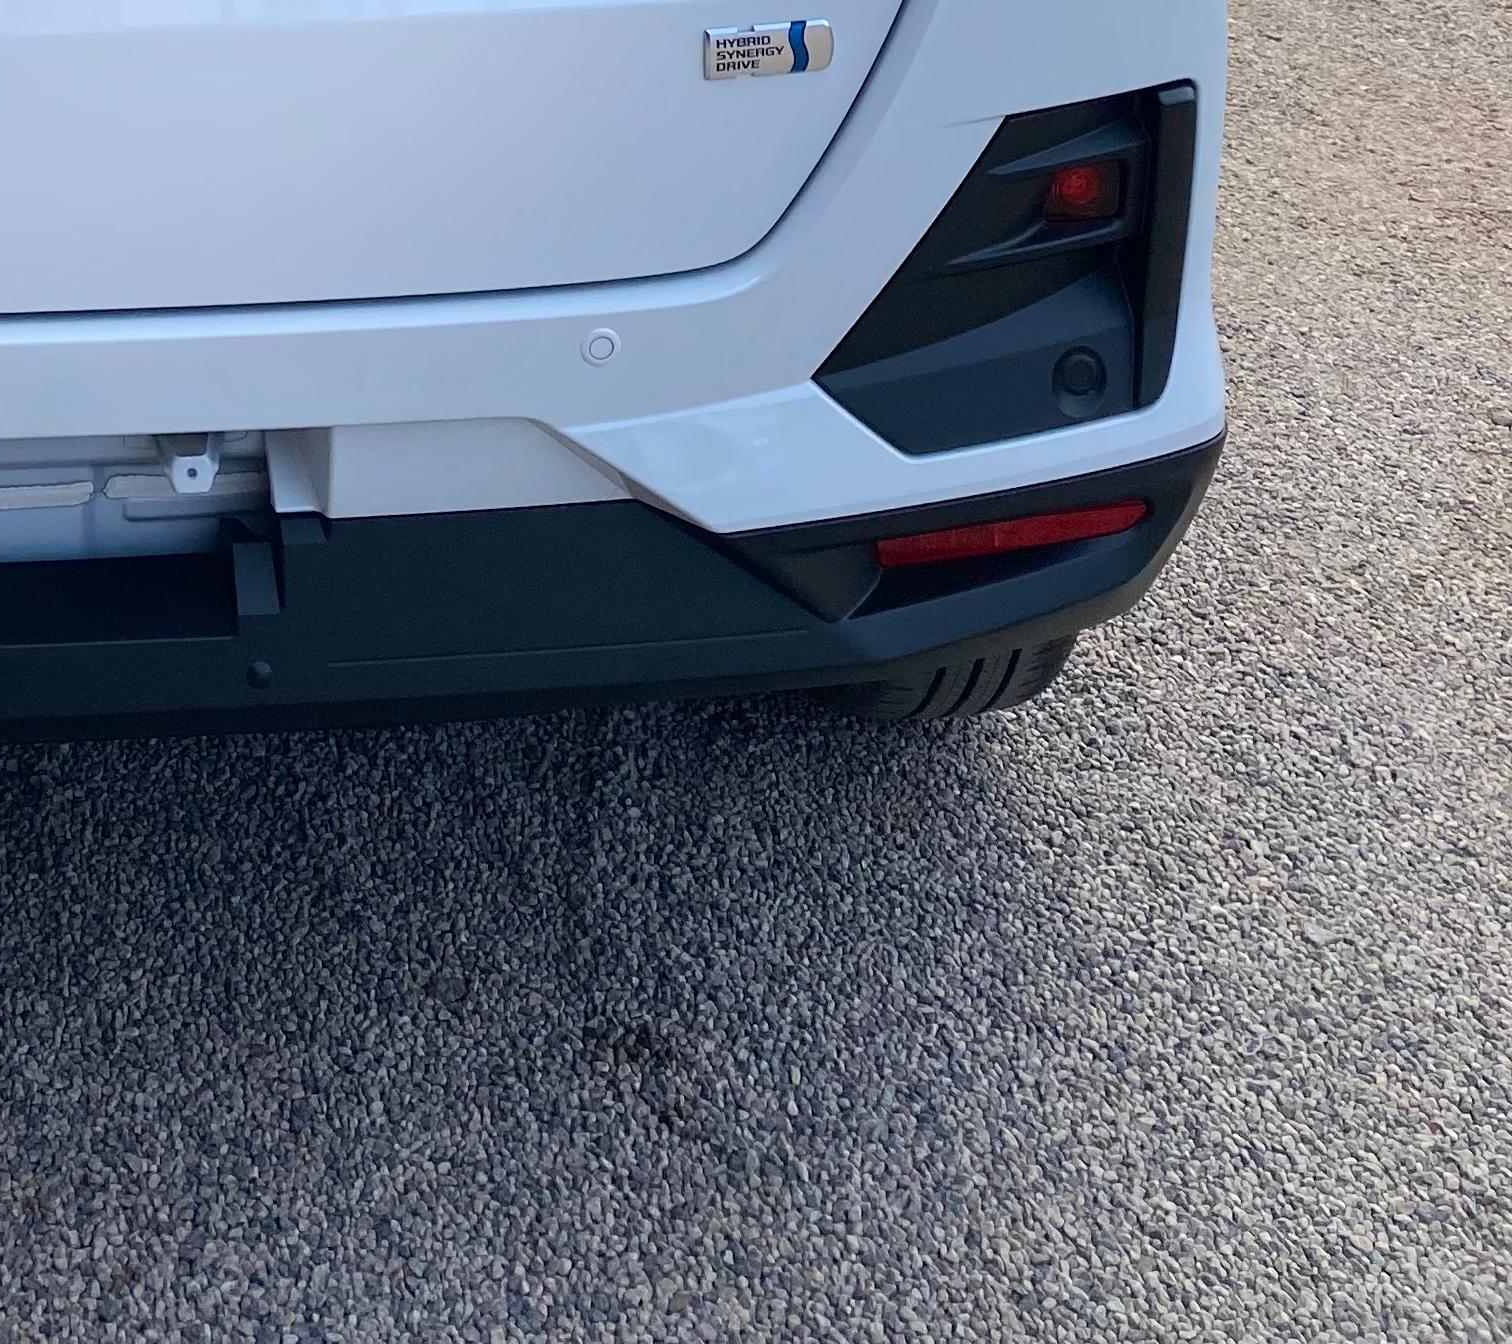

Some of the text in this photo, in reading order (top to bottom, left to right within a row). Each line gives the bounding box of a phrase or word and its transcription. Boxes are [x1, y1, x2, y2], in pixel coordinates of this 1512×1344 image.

[716, 35, 771, 49] HYBRID
[716, 46, 785, 61] SYNERGY
[716, 60, 760, 72] DRIVE
